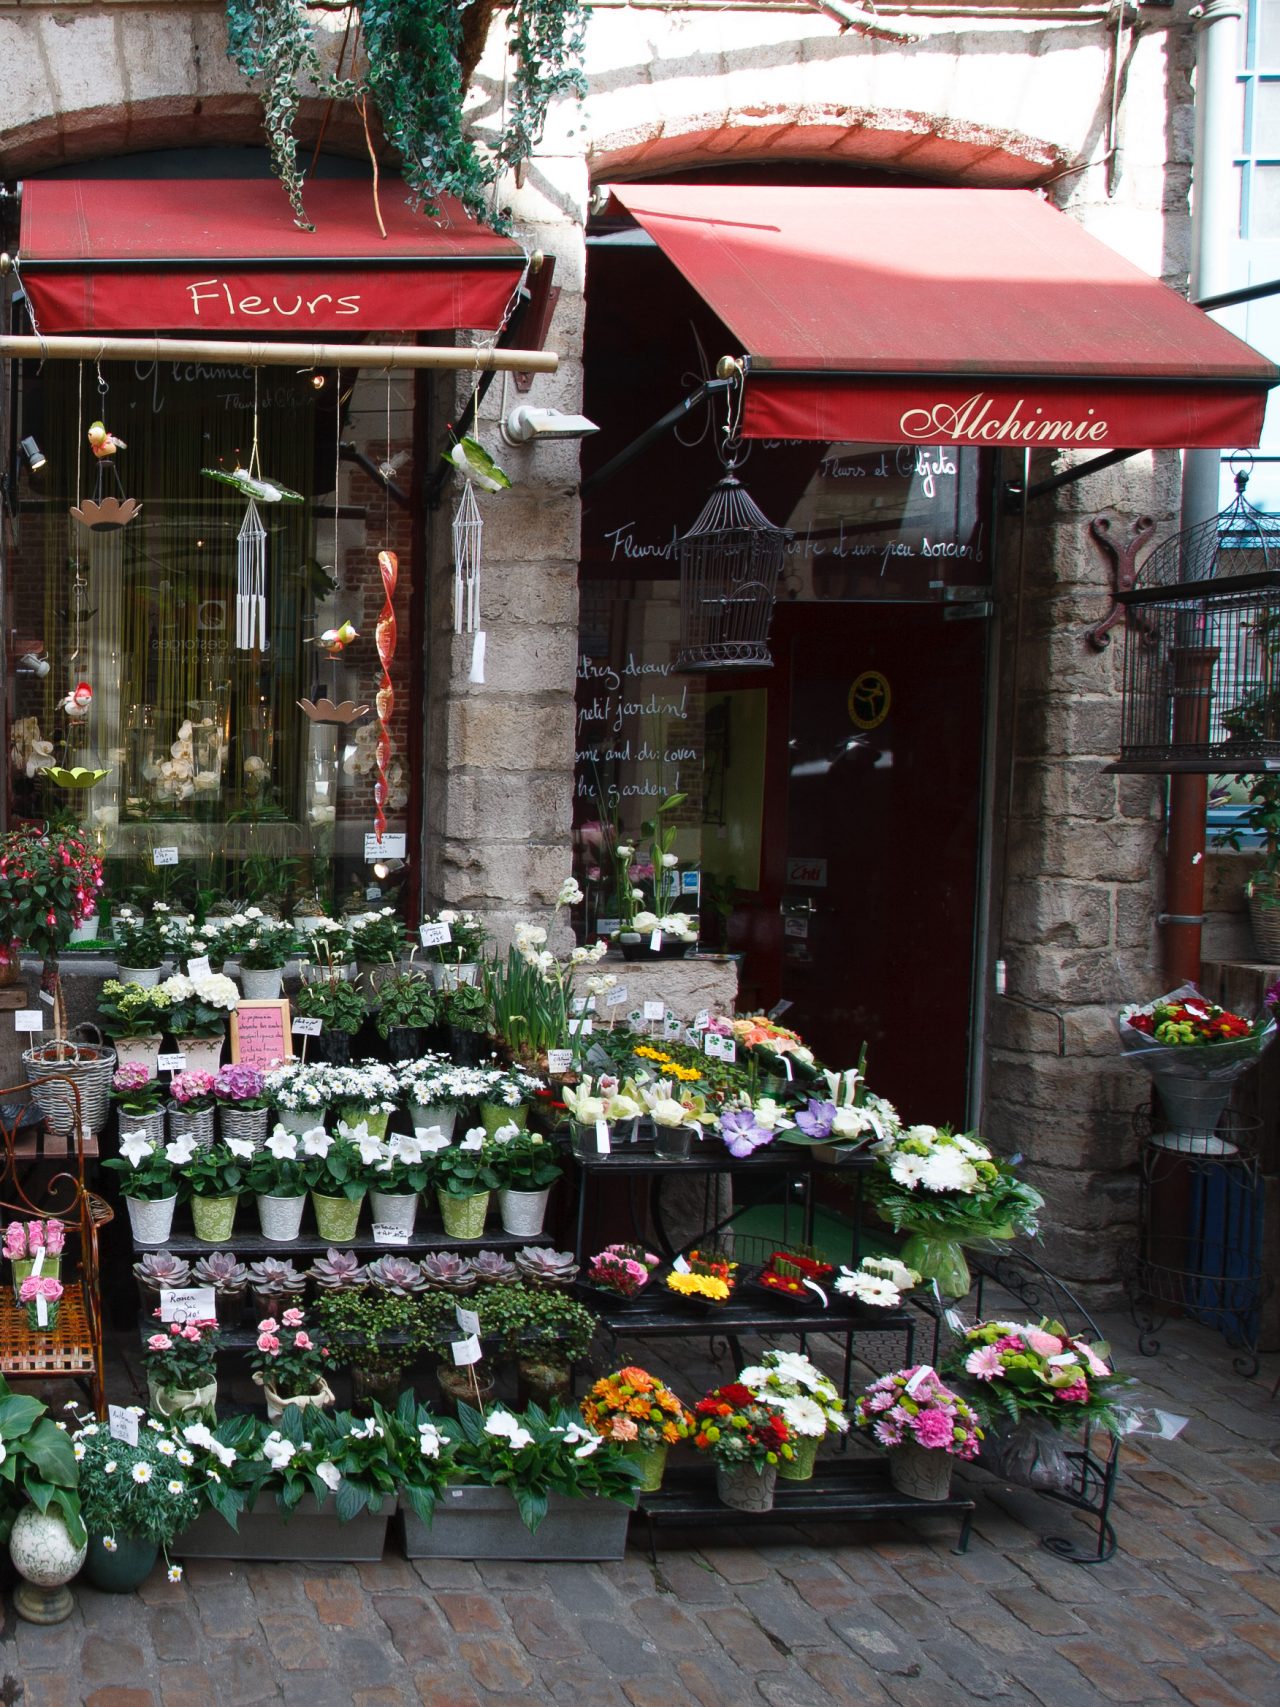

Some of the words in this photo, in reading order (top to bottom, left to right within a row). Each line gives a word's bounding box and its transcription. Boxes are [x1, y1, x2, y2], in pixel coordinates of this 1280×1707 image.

[186, 279, 361, 316] Fleurs
[899, 391, 1109, 441] Alchimie
[820, 456, 867, 477] Fleurs
[873, 453, 889, 477] et
[832, 519, 848, 558] et
[852, 542, 876, 557] un
[879, 540, 915, 577] peu
[577, 697, 611, 736] petit
[605, 739, 631, 761] and
